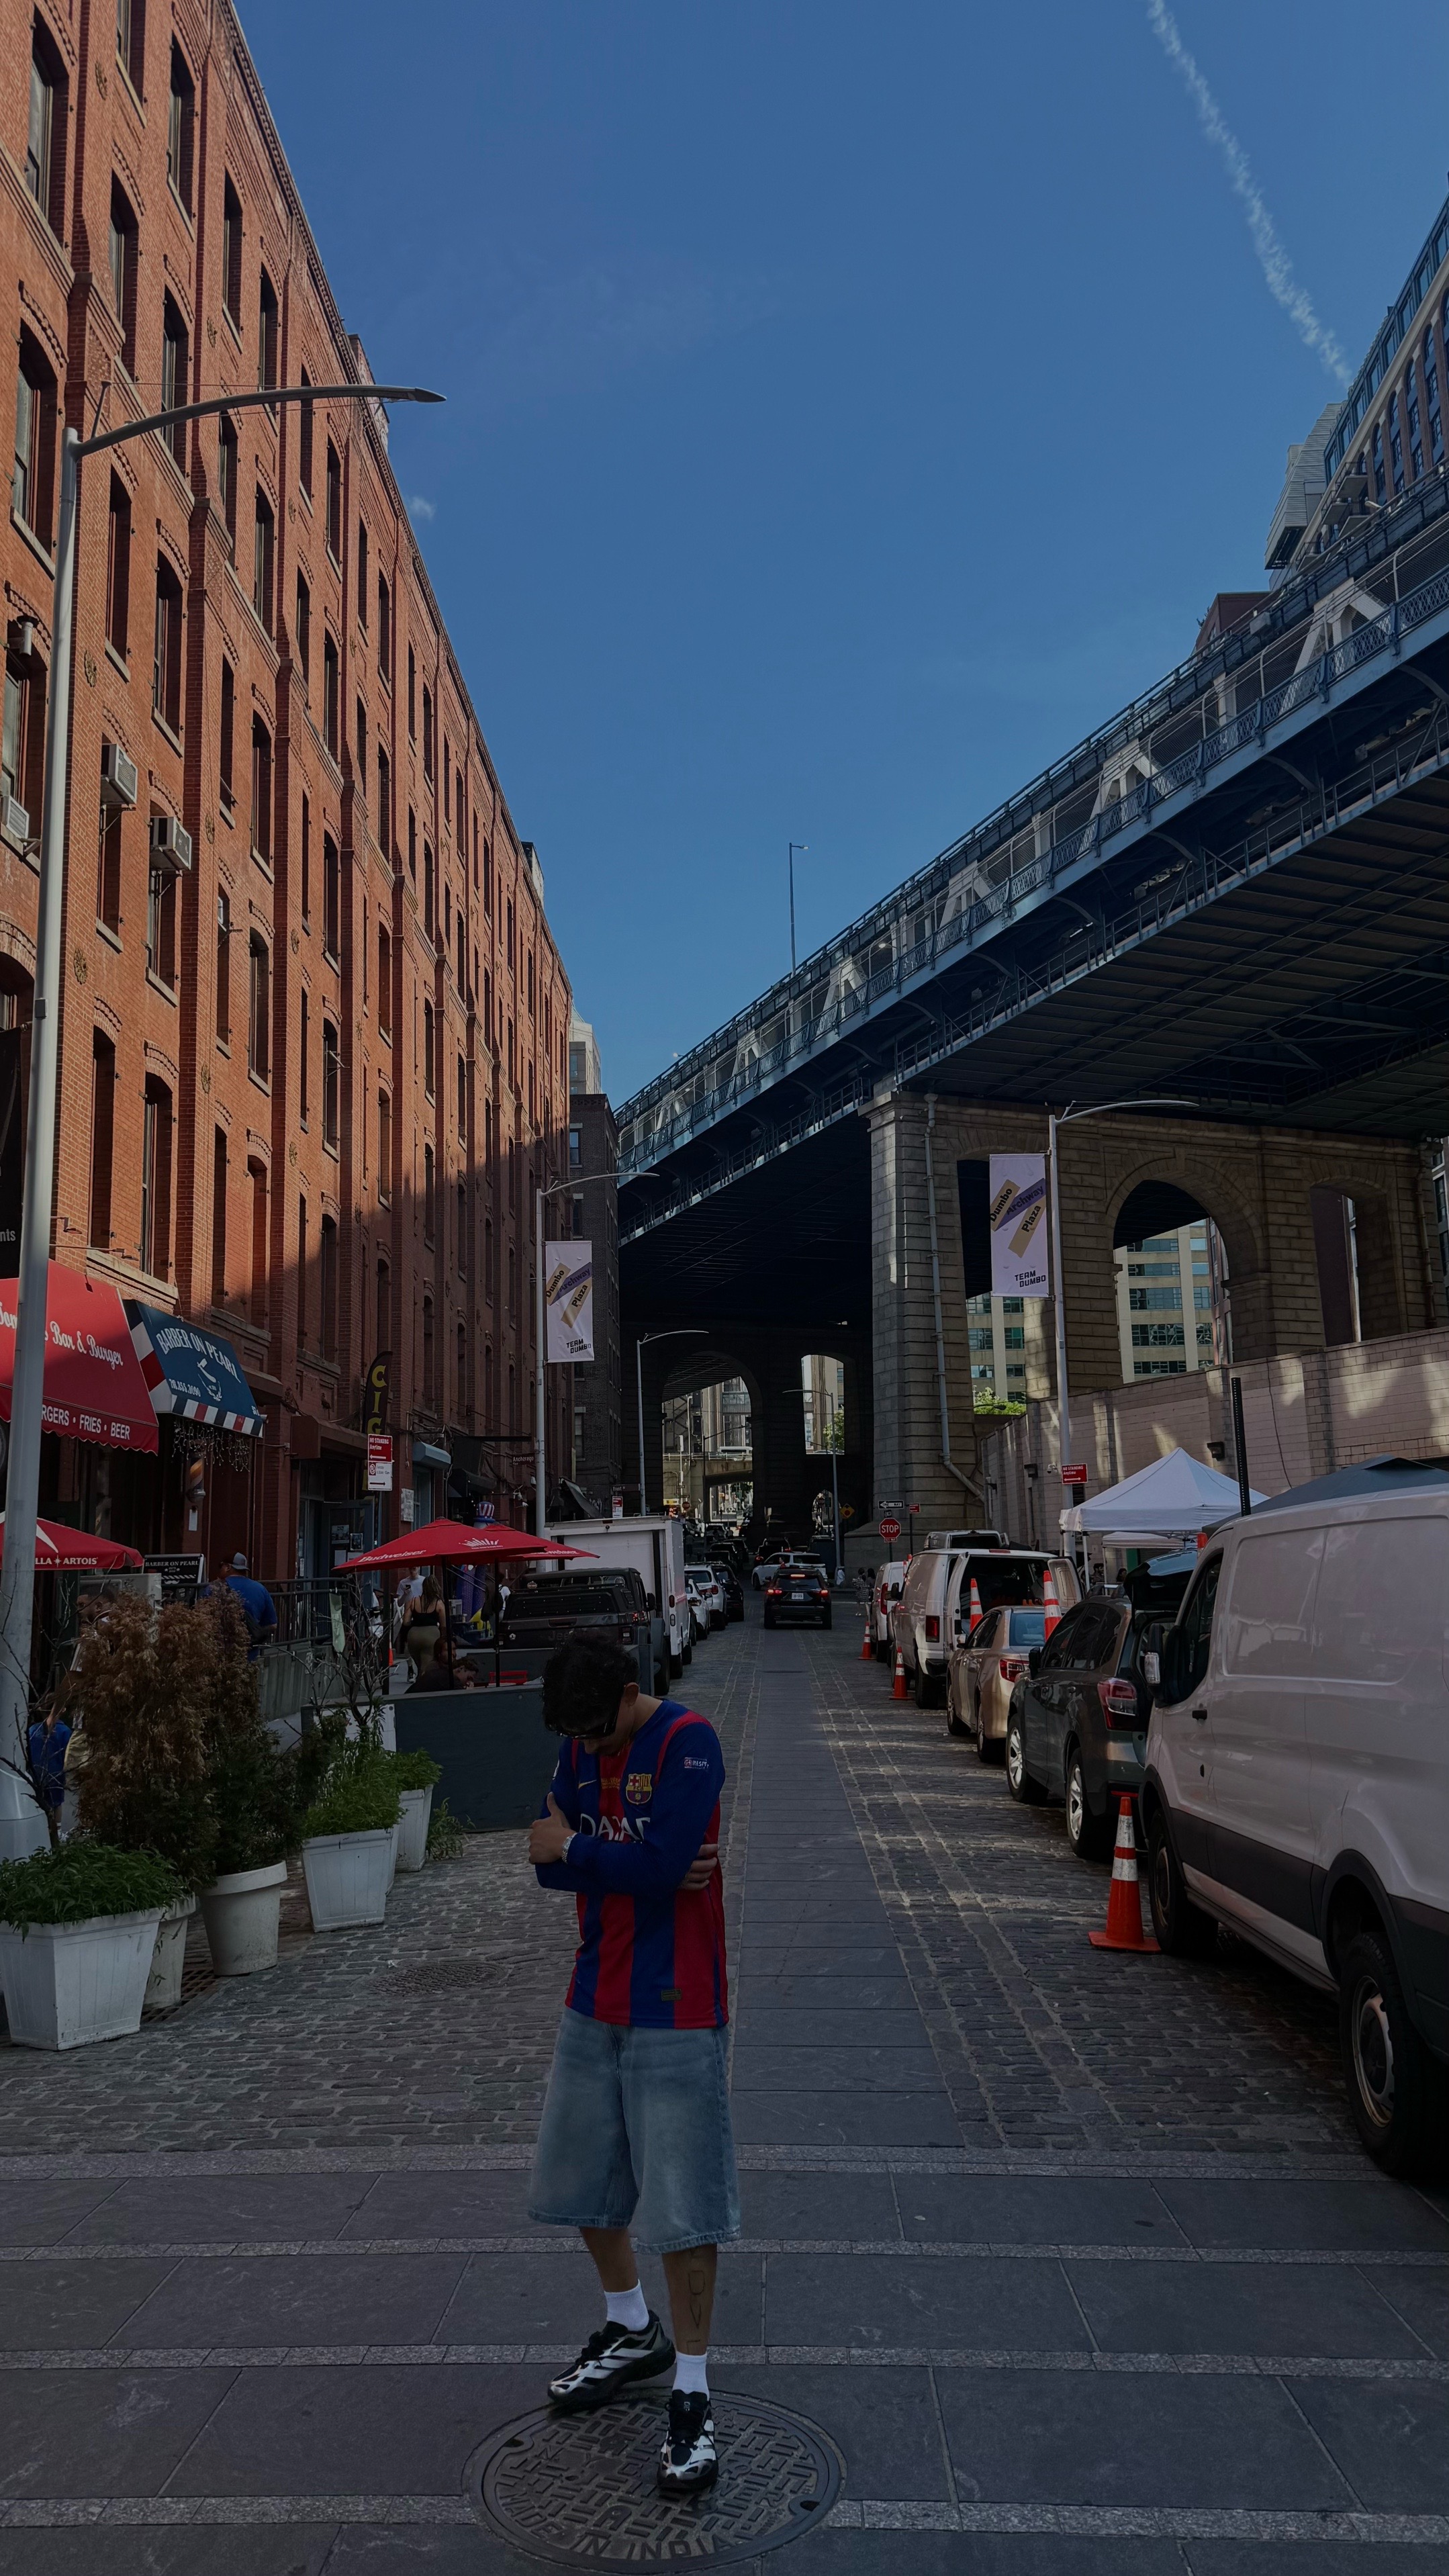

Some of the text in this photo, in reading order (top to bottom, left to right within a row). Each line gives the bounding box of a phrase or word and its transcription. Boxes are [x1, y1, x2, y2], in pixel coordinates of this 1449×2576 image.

[990, 1188, 1013, 1222] Dumbo
[1007, 1186, 1043, 1215] Archway
[1021, 1205, 1041, 1232] Plaza
[546, 1270, 565, 1298] Dumbo
[559, 1268, 591, 1294] Archway
[1015, 1270, 1036, 1281] TEAM
[1020, 1275, 1046, 1287] DUMBO
[571, 1284, 588, 1307] Plaza
[50, 1321, 75, 1350] Bar
[77, 1330, 87, 1354] &
[87, 1334, 124, 1370] Burger
[156, 1328, 241, 1383] BARBER ON PEARL
[566, 1338, 583, 1348] TEAM
[570, 1343, 592, 1354] DUMBO
[42, 1404, 130, 1440] RGERS FRIES BEER
[357, 1550, 426, 1563] Budweiser
[548, 1630, 573, 1641] Jee
